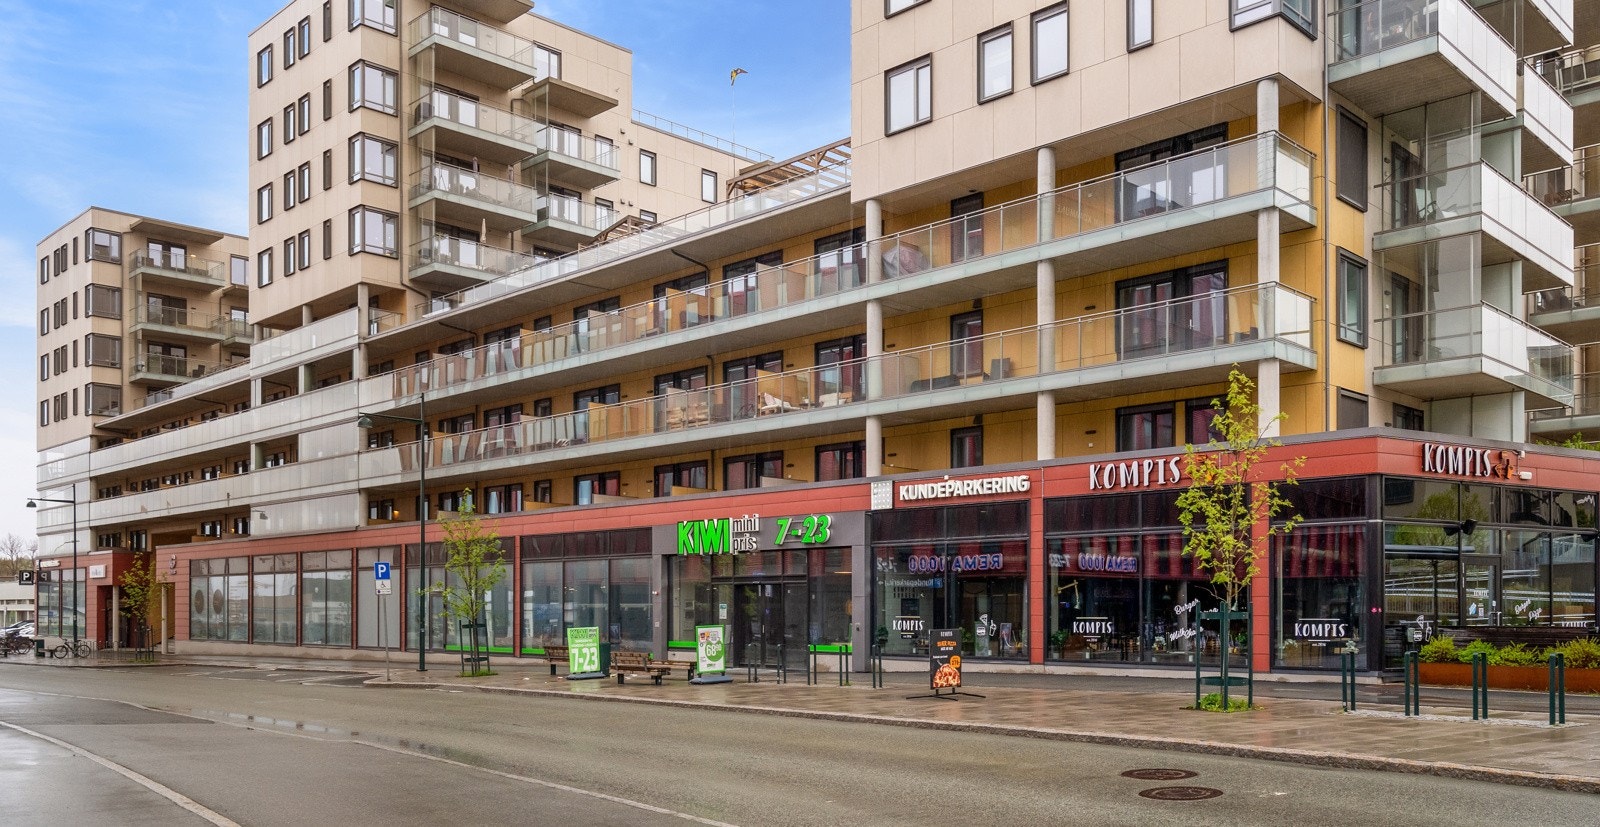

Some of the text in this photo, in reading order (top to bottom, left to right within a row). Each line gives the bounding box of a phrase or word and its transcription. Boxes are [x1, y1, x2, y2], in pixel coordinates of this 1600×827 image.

[1424, 443, 1491, 477] KOMPIS
[1089, 456, 1181, 490] KOMPIS
[899, 475, 1030, 500] KUNDEPARKERING
[732, 514, 759, 532] mini
[774, 514, 831, 545] 7-23
[677, 517, 730, 555] KIWI
[732, 533, 757, 554] pris
[23, 572, 30, 581] P
[378, 564, 386, 578] P
[892, 620, 924, 631] KOMPIS
[1073, 621, 1112, 634] KOMPIS
[1294, 623, 1345, 637] KOMPIS
[571, 647, 598, 671] 7-23
